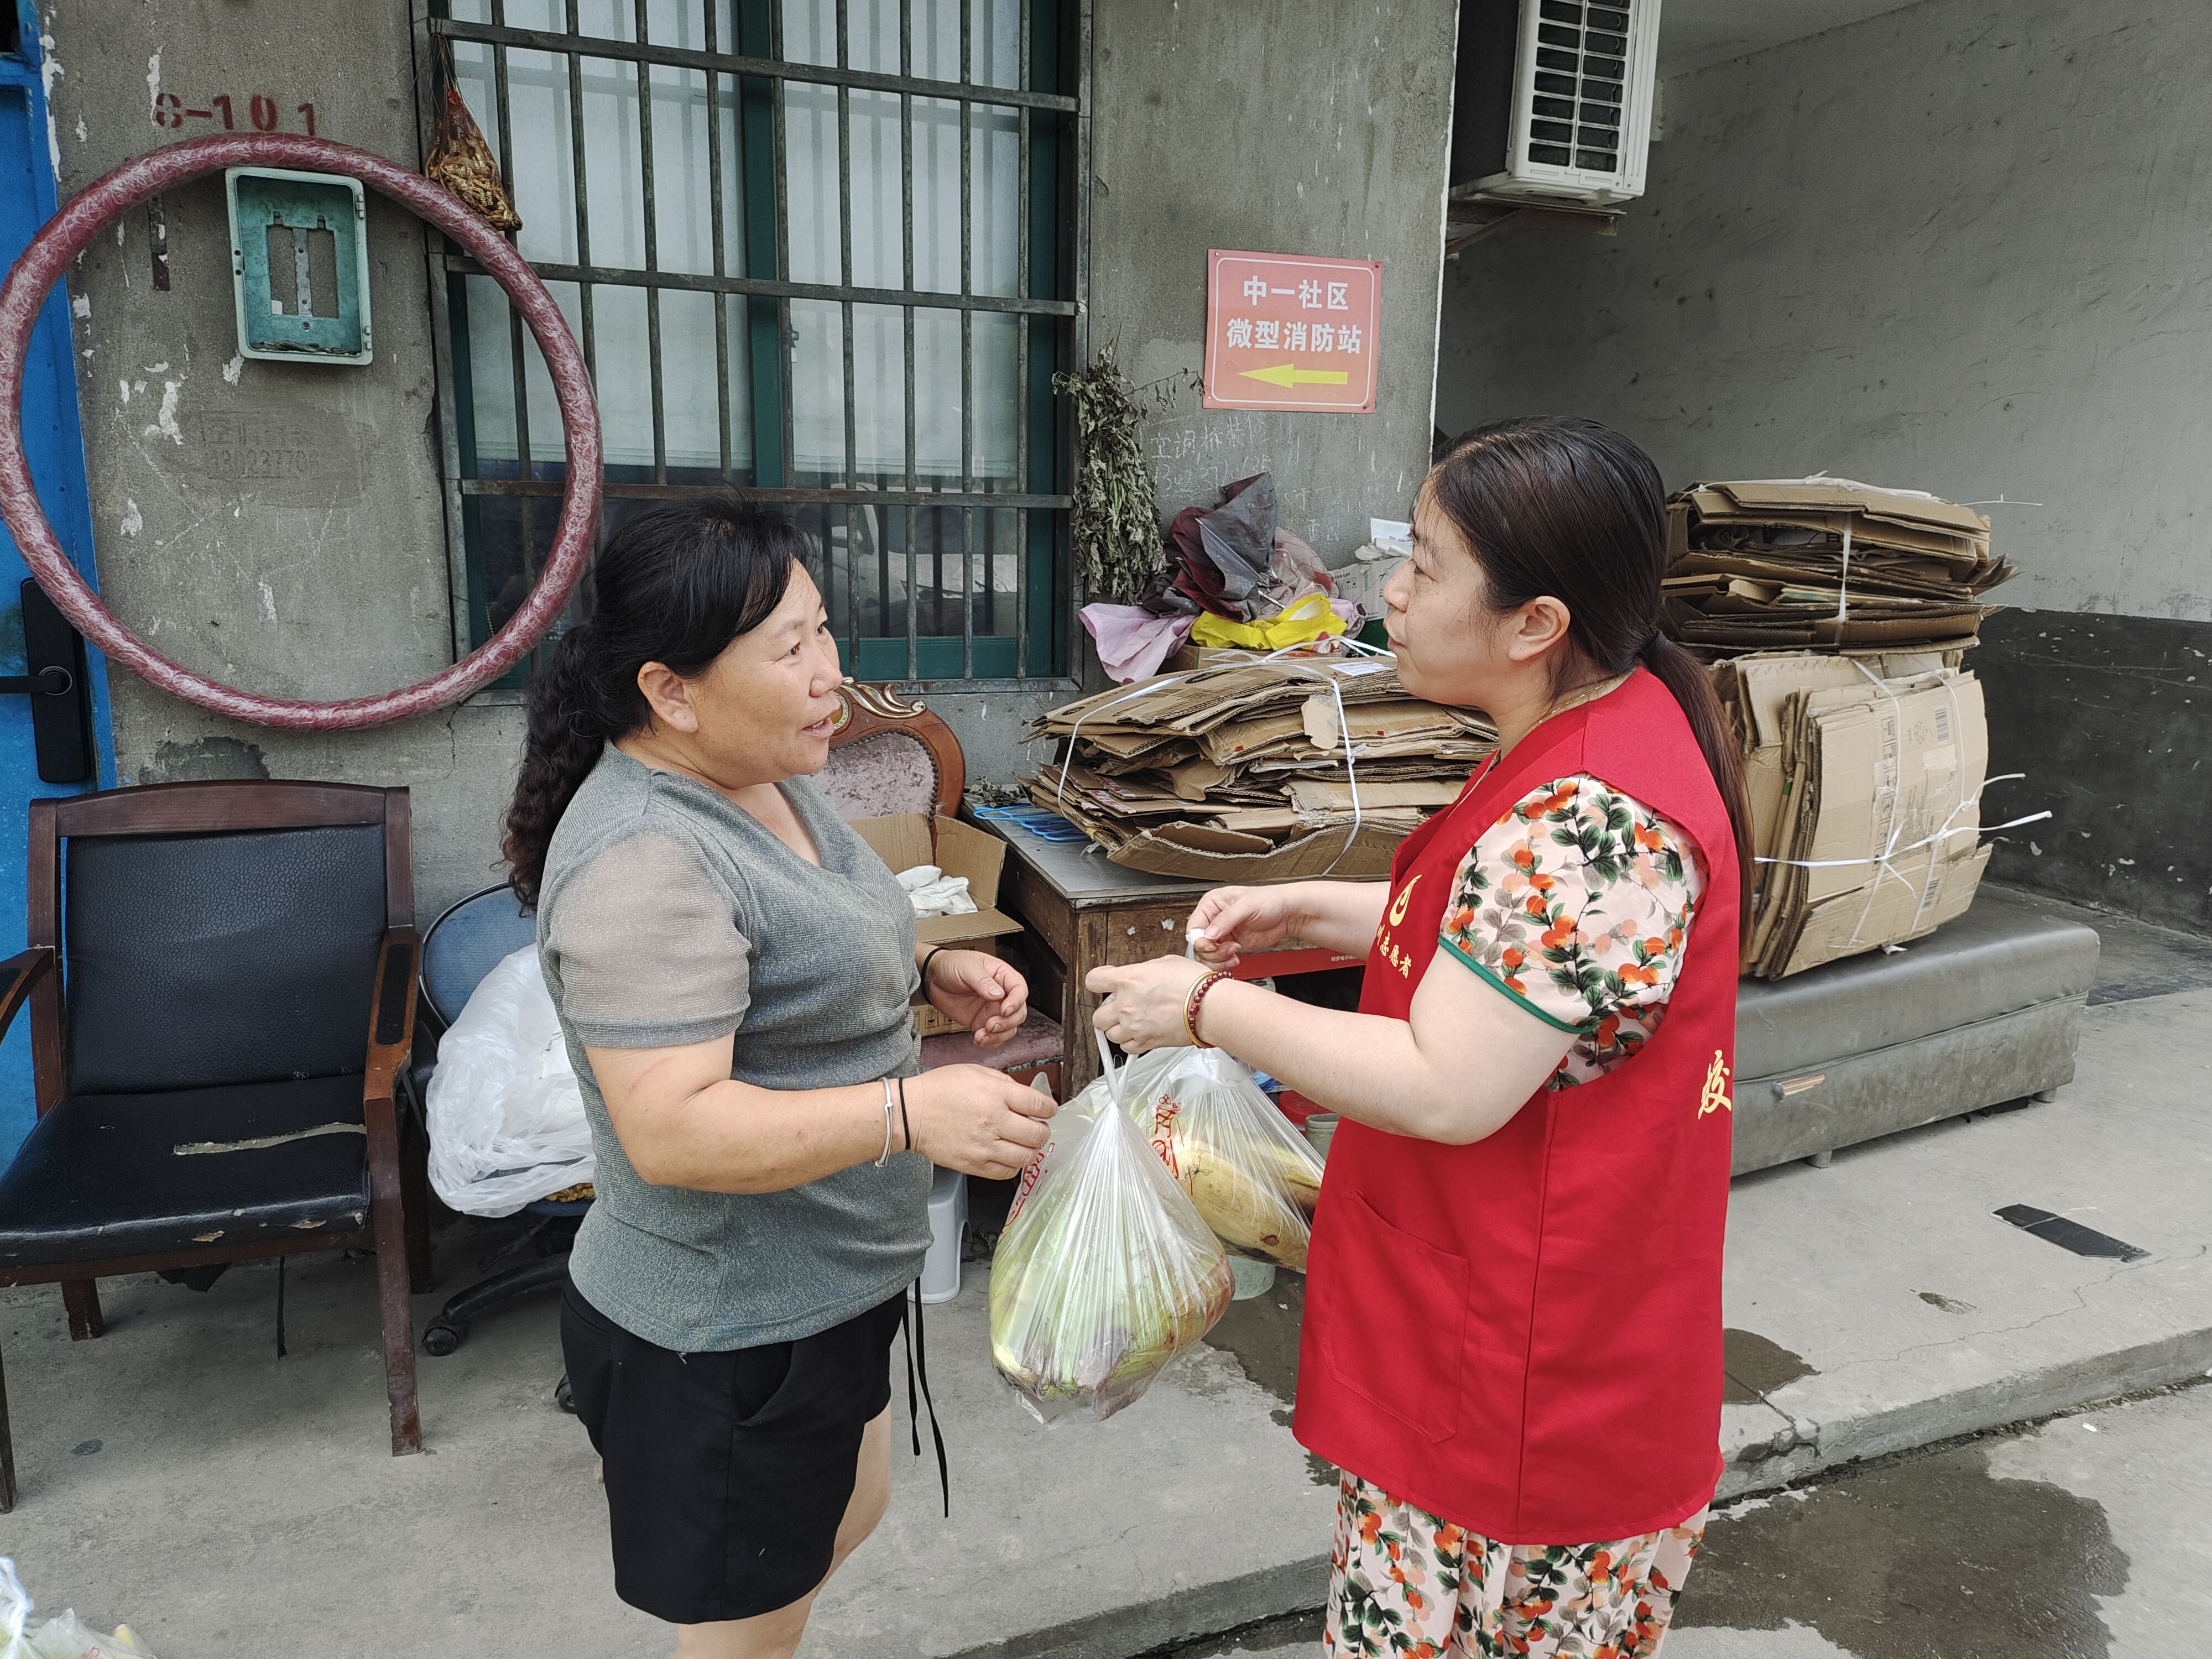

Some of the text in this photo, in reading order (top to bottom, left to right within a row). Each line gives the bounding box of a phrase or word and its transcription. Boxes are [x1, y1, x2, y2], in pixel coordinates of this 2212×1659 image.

[1243, 275, 1349, 311] 中一社区
[1227, 317, 1362, 354] 微型消防站
